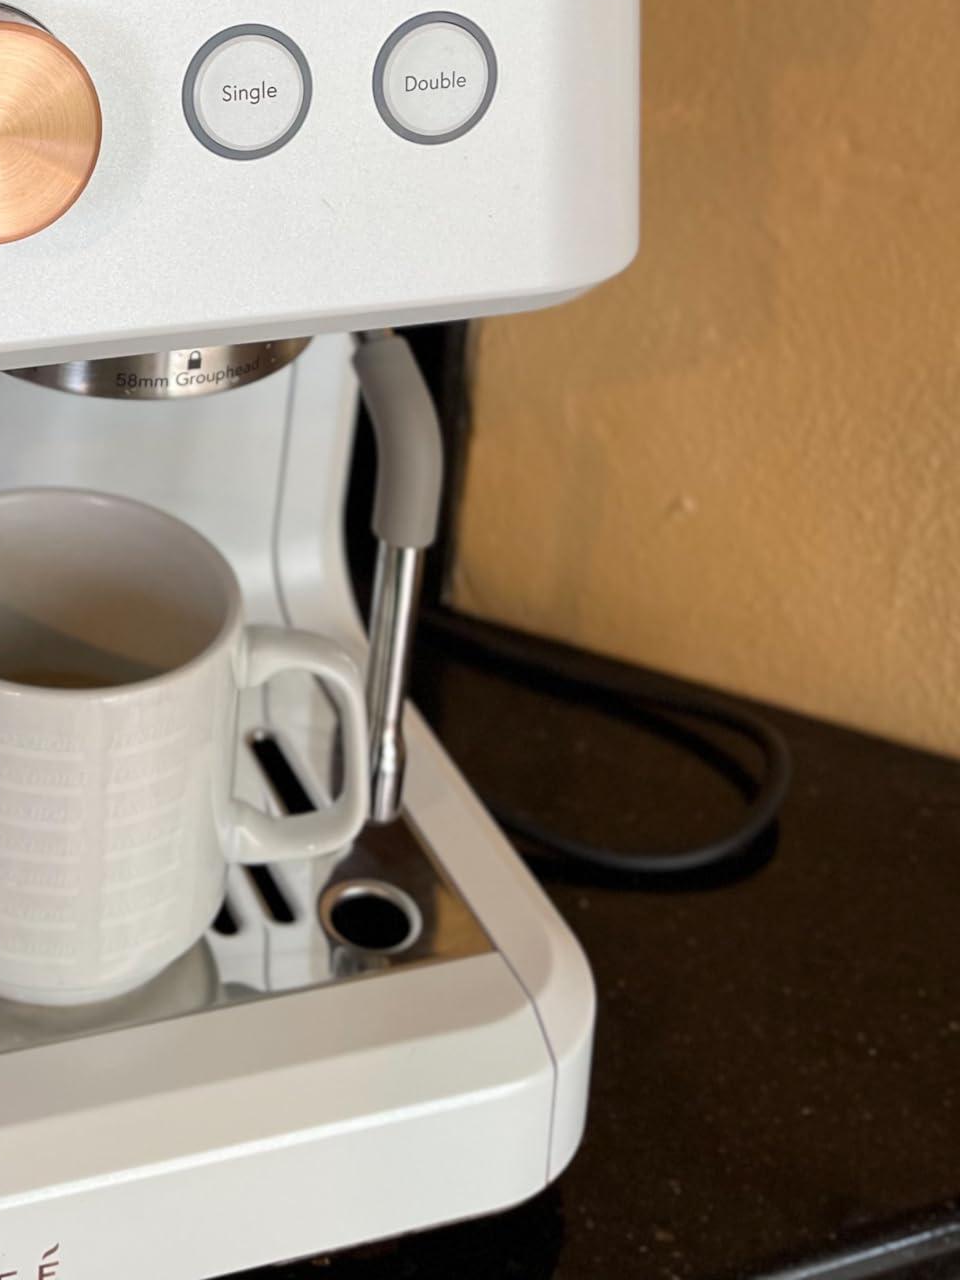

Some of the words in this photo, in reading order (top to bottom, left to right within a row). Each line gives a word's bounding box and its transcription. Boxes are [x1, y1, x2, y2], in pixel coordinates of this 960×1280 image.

[221, 81, 279, 106] Single
[404, 71, 467, 94] Double
[116, 372, 169, 387] 58mm
[175, 356, 261, 387] Grouphead
